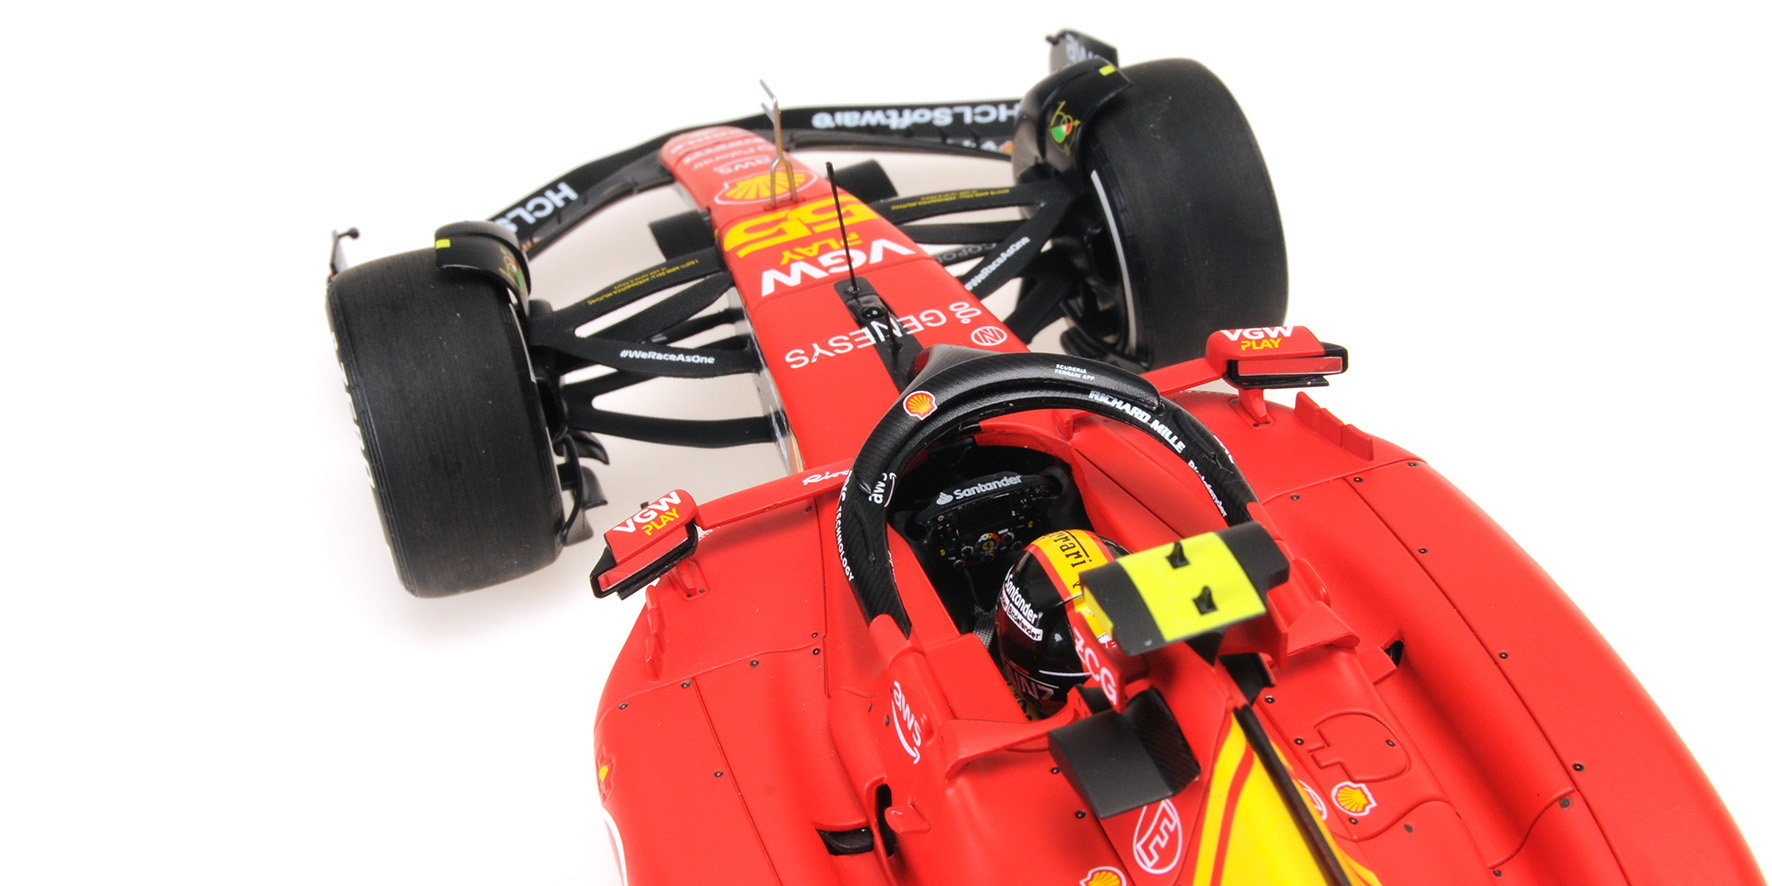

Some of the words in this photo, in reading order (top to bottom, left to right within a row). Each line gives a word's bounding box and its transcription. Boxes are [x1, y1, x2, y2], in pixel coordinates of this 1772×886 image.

[723, 195, 879, 259] 55
[761, 238, 916, 297] VGW
[779, 232, 862, 266] PLAY
[785, 309, 947, 369] GENESYS
[1220, 326, 1294, 341] VGW
[1241, 338, 1281, 351] PLAY
[620, 349, 715, 364] #WeRaceAsOne
[1089, 390, 1150, 421] RICHARD
[1150, 419, 1186, 454] MILLE
[953, 475, 1022, 500] Santander
[613, 490, 682, 535] VGW
[641, 507, 681, 536] PLAY
[835, 505, 855, 582] TECHNOLOGY
